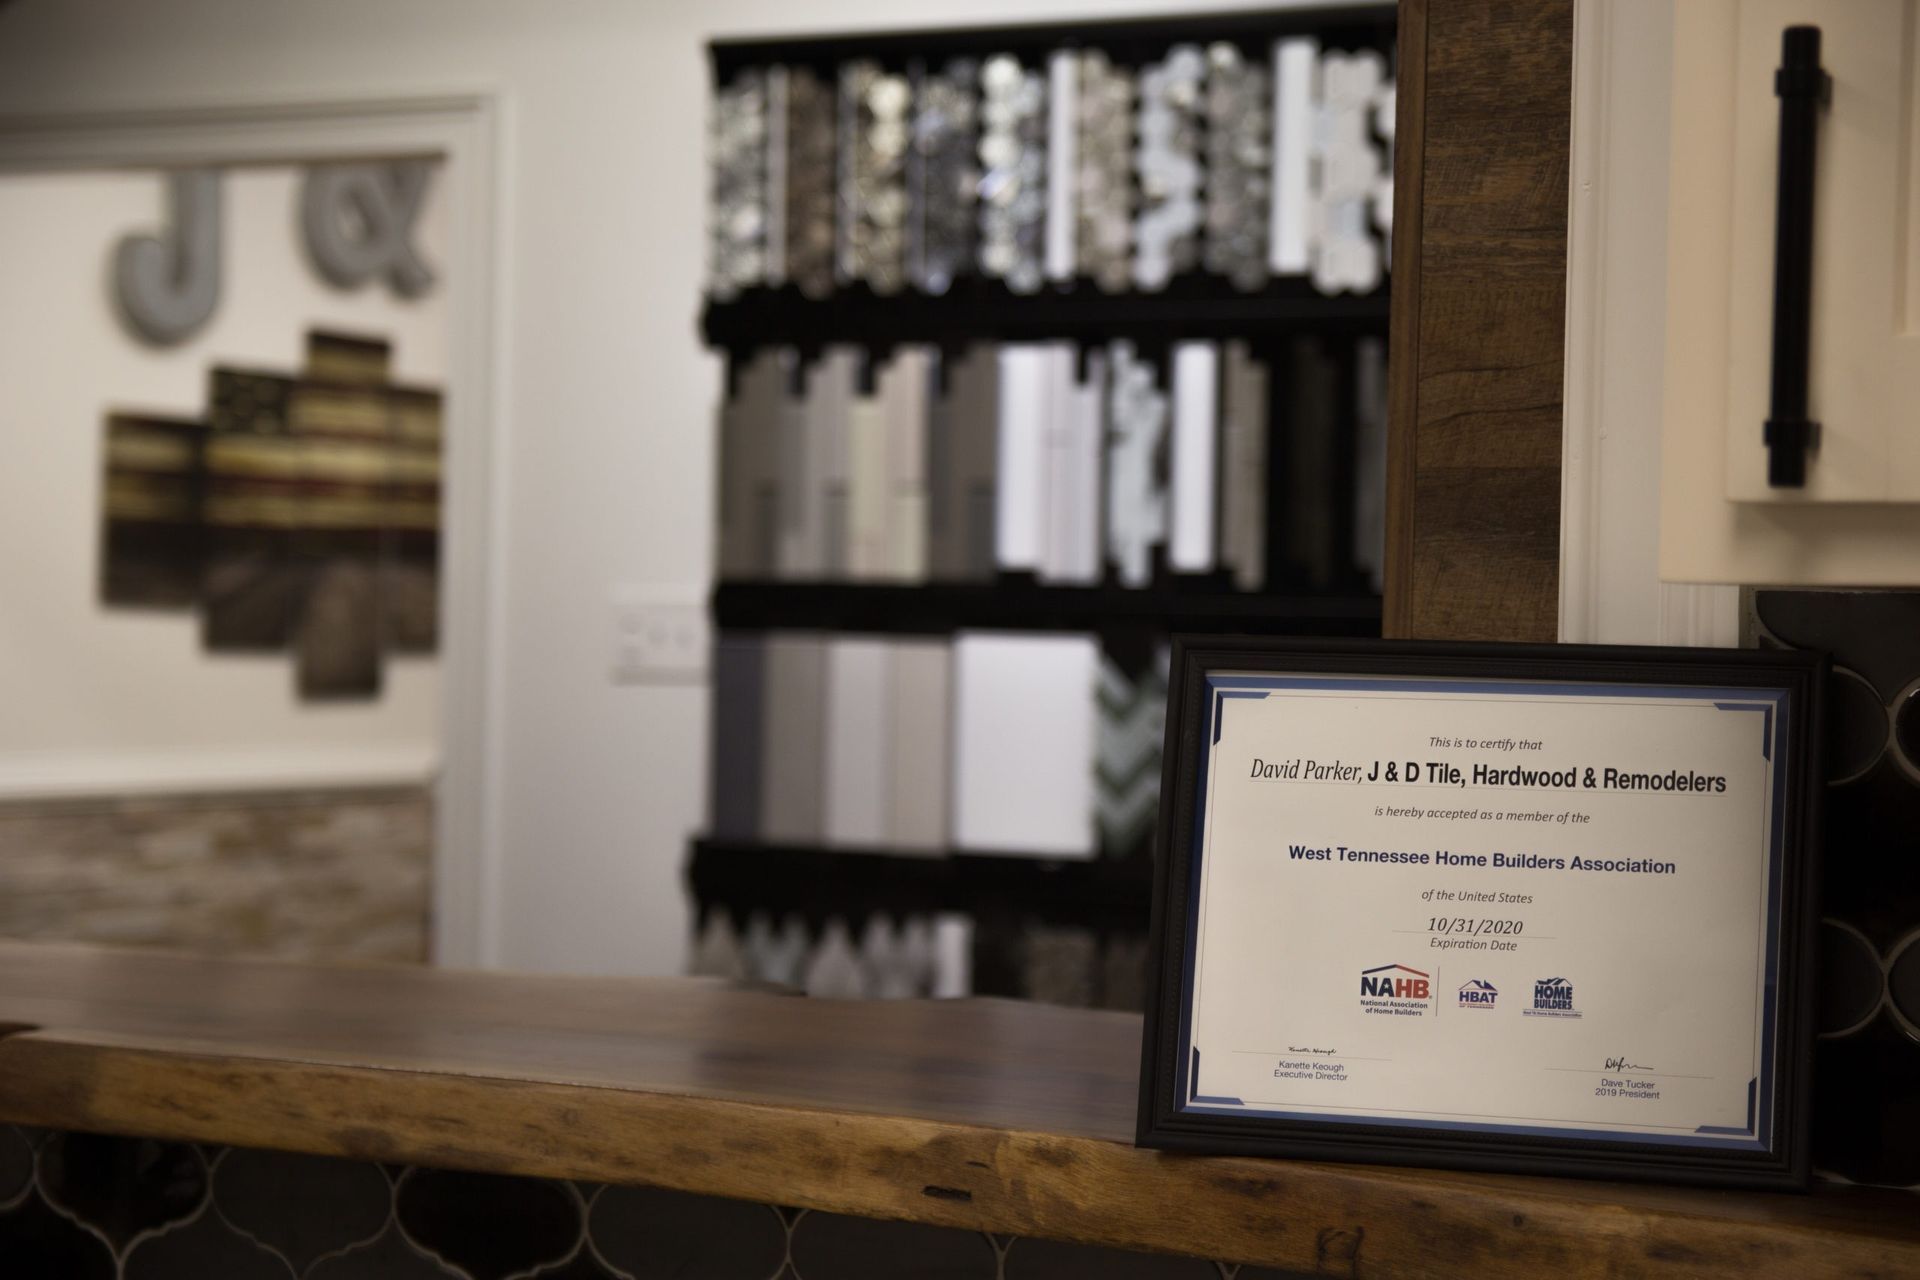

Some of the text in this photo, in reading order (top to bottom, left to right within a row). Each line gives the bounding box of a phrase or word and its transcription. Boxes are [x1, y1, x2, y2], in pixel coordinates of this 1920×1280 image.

[1430, 736, 1543, 752] This is to certify that
[1249, 758, 1727, 794] David Parker, J & D Tile, Hardwood & Remodelers
[1374, 804, 1591, 825] is hereby accepted as a member of the
[1288, 844, 1676, 875] West Tennessee Home Builders Association
[1421, 888, 1534, 904] of the United States
[1428, 917, 1524, 937] 10/31/2020
[1430, 937, 1518, 951] Expiration Date
[1360, 976, 1430, 999] NAHB
[1534, 985, 1573, 1000] HOME
[1459, 991, 1498, 1003] HBAT
[1390, 1001, 1428, 1009] Association
[1534, 999, 1573, 1010] BUILDERS
[1394, 1009, 1423, 1017] Builders
[1279, 1060, 1345, 1074] Kanette Keough
[1273, 1069, 1348, 1081] Executive Director
[1601, 1078, 1656, 1090] Dave Tucker
[1595, 1087, 1660, 1100] 2019 President
